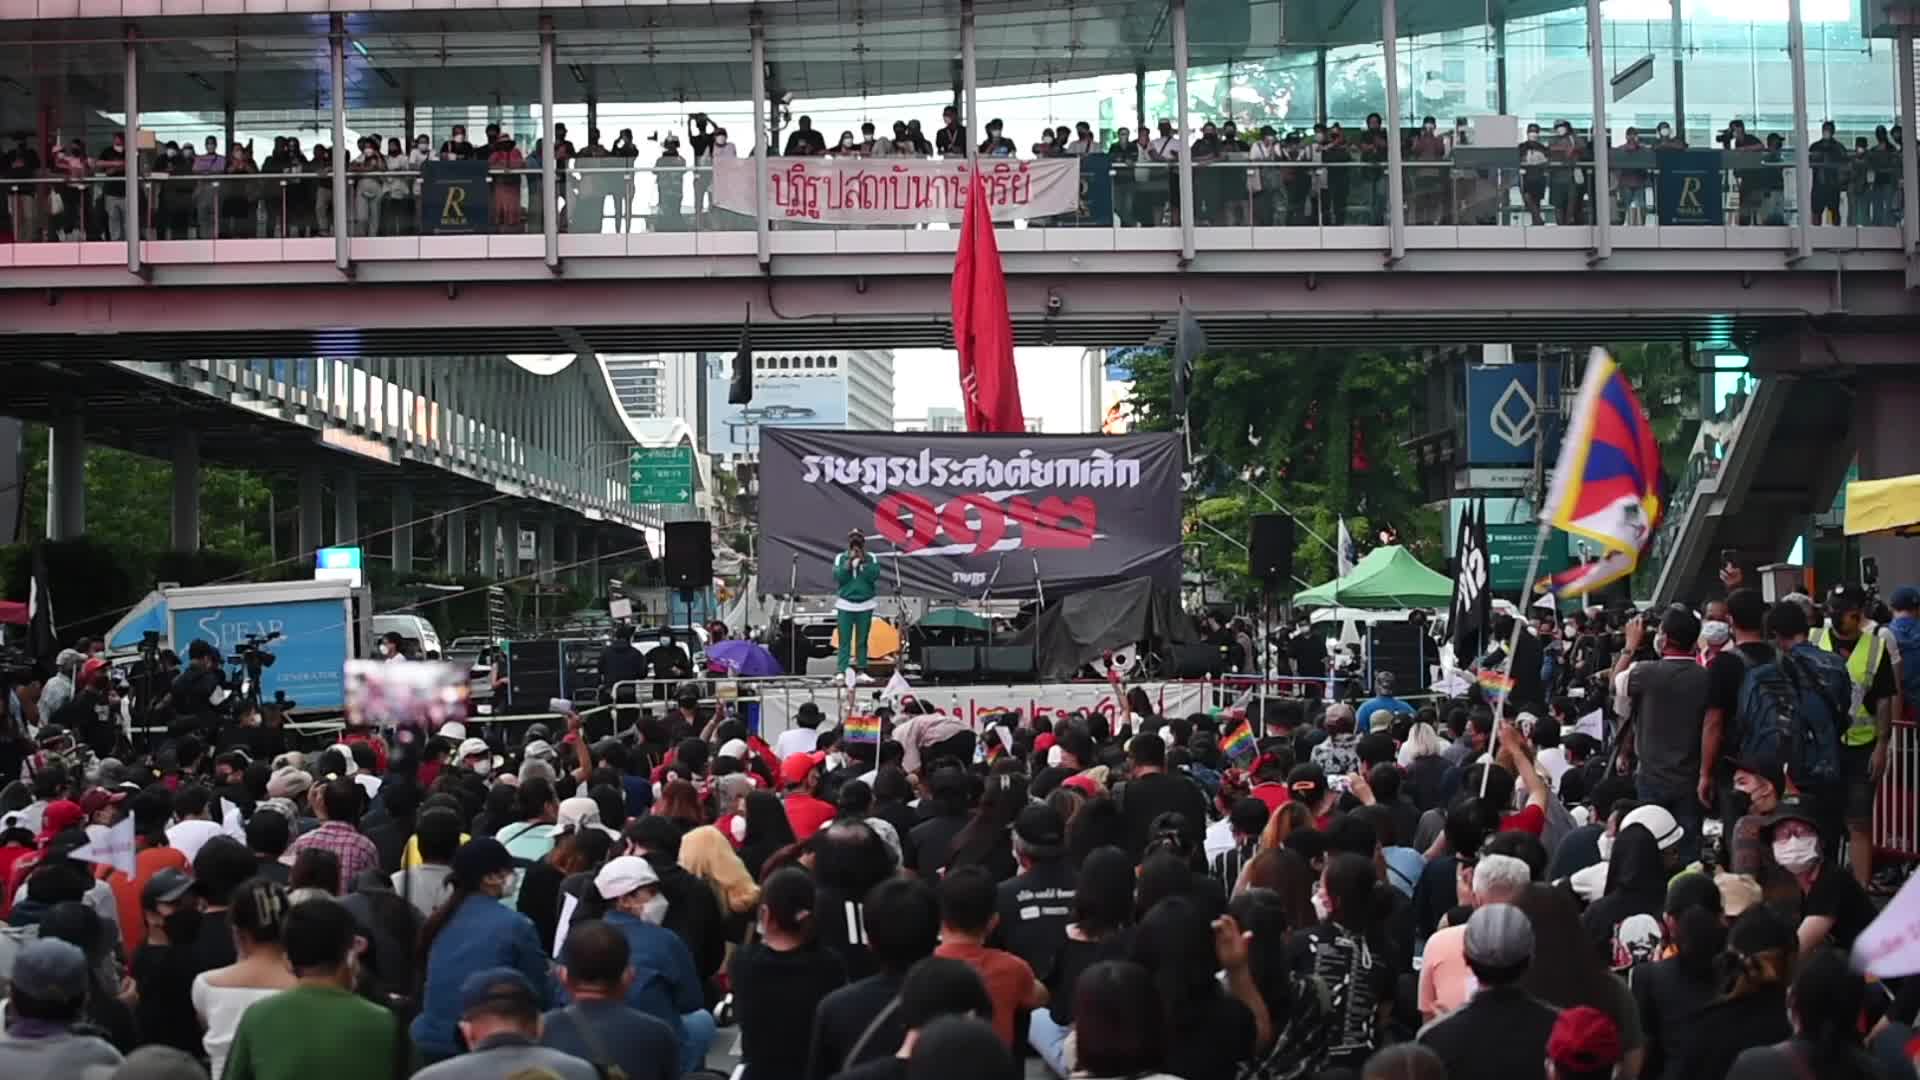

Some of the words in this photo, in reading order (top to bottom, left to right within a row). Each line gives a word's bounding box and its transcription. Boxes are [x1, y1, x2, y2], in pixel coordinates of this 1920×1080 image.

[443, 186, 466, 217] R
[1680, 176, 1702, 206] R
[801, 447, 1141, 495] ราษฎรประสงค์ยกเลิก
